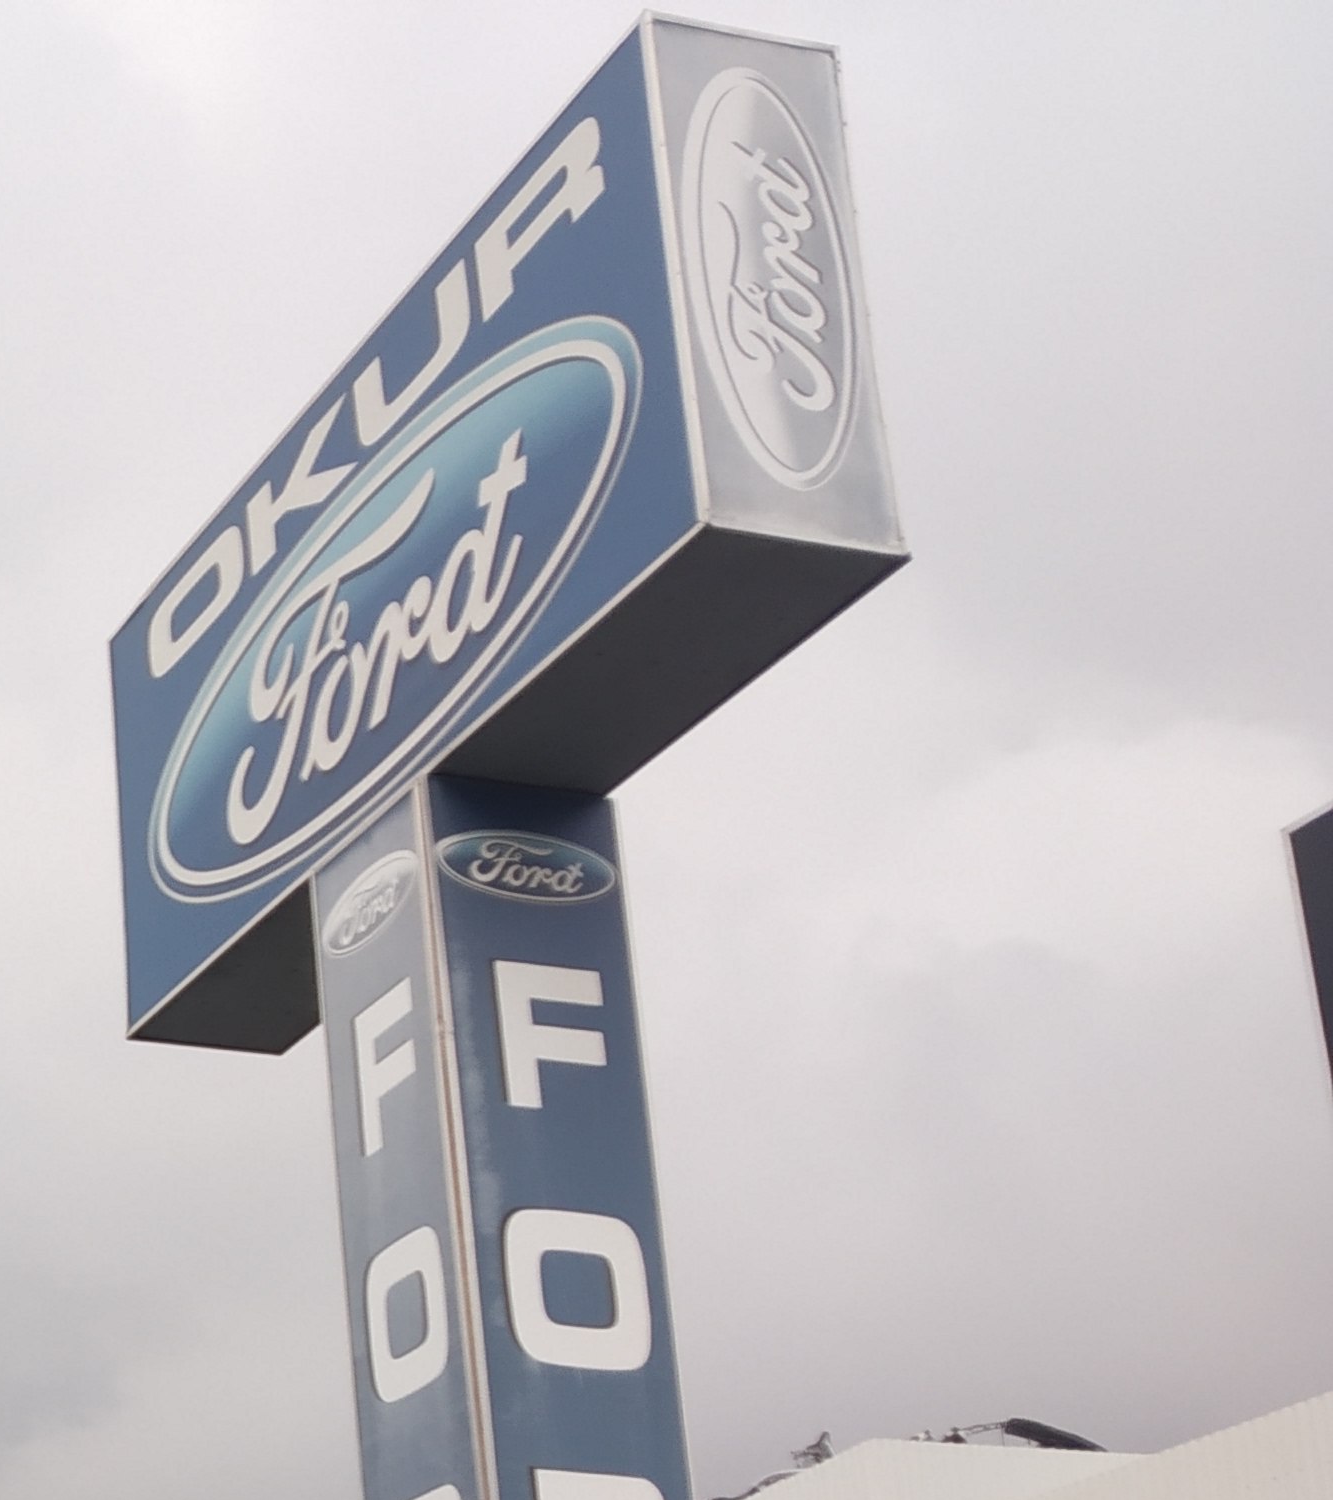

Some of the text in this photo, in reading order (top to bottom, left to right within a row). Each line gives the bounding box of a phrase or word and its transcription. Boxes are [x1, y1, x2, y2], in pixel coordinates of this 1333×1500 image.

[147, 116, 606, 679] OKUR
[718, 140, 837, 412] Ford
[226, 428, 528, 845] Ford
[468, 839, 585, 893] Ford
